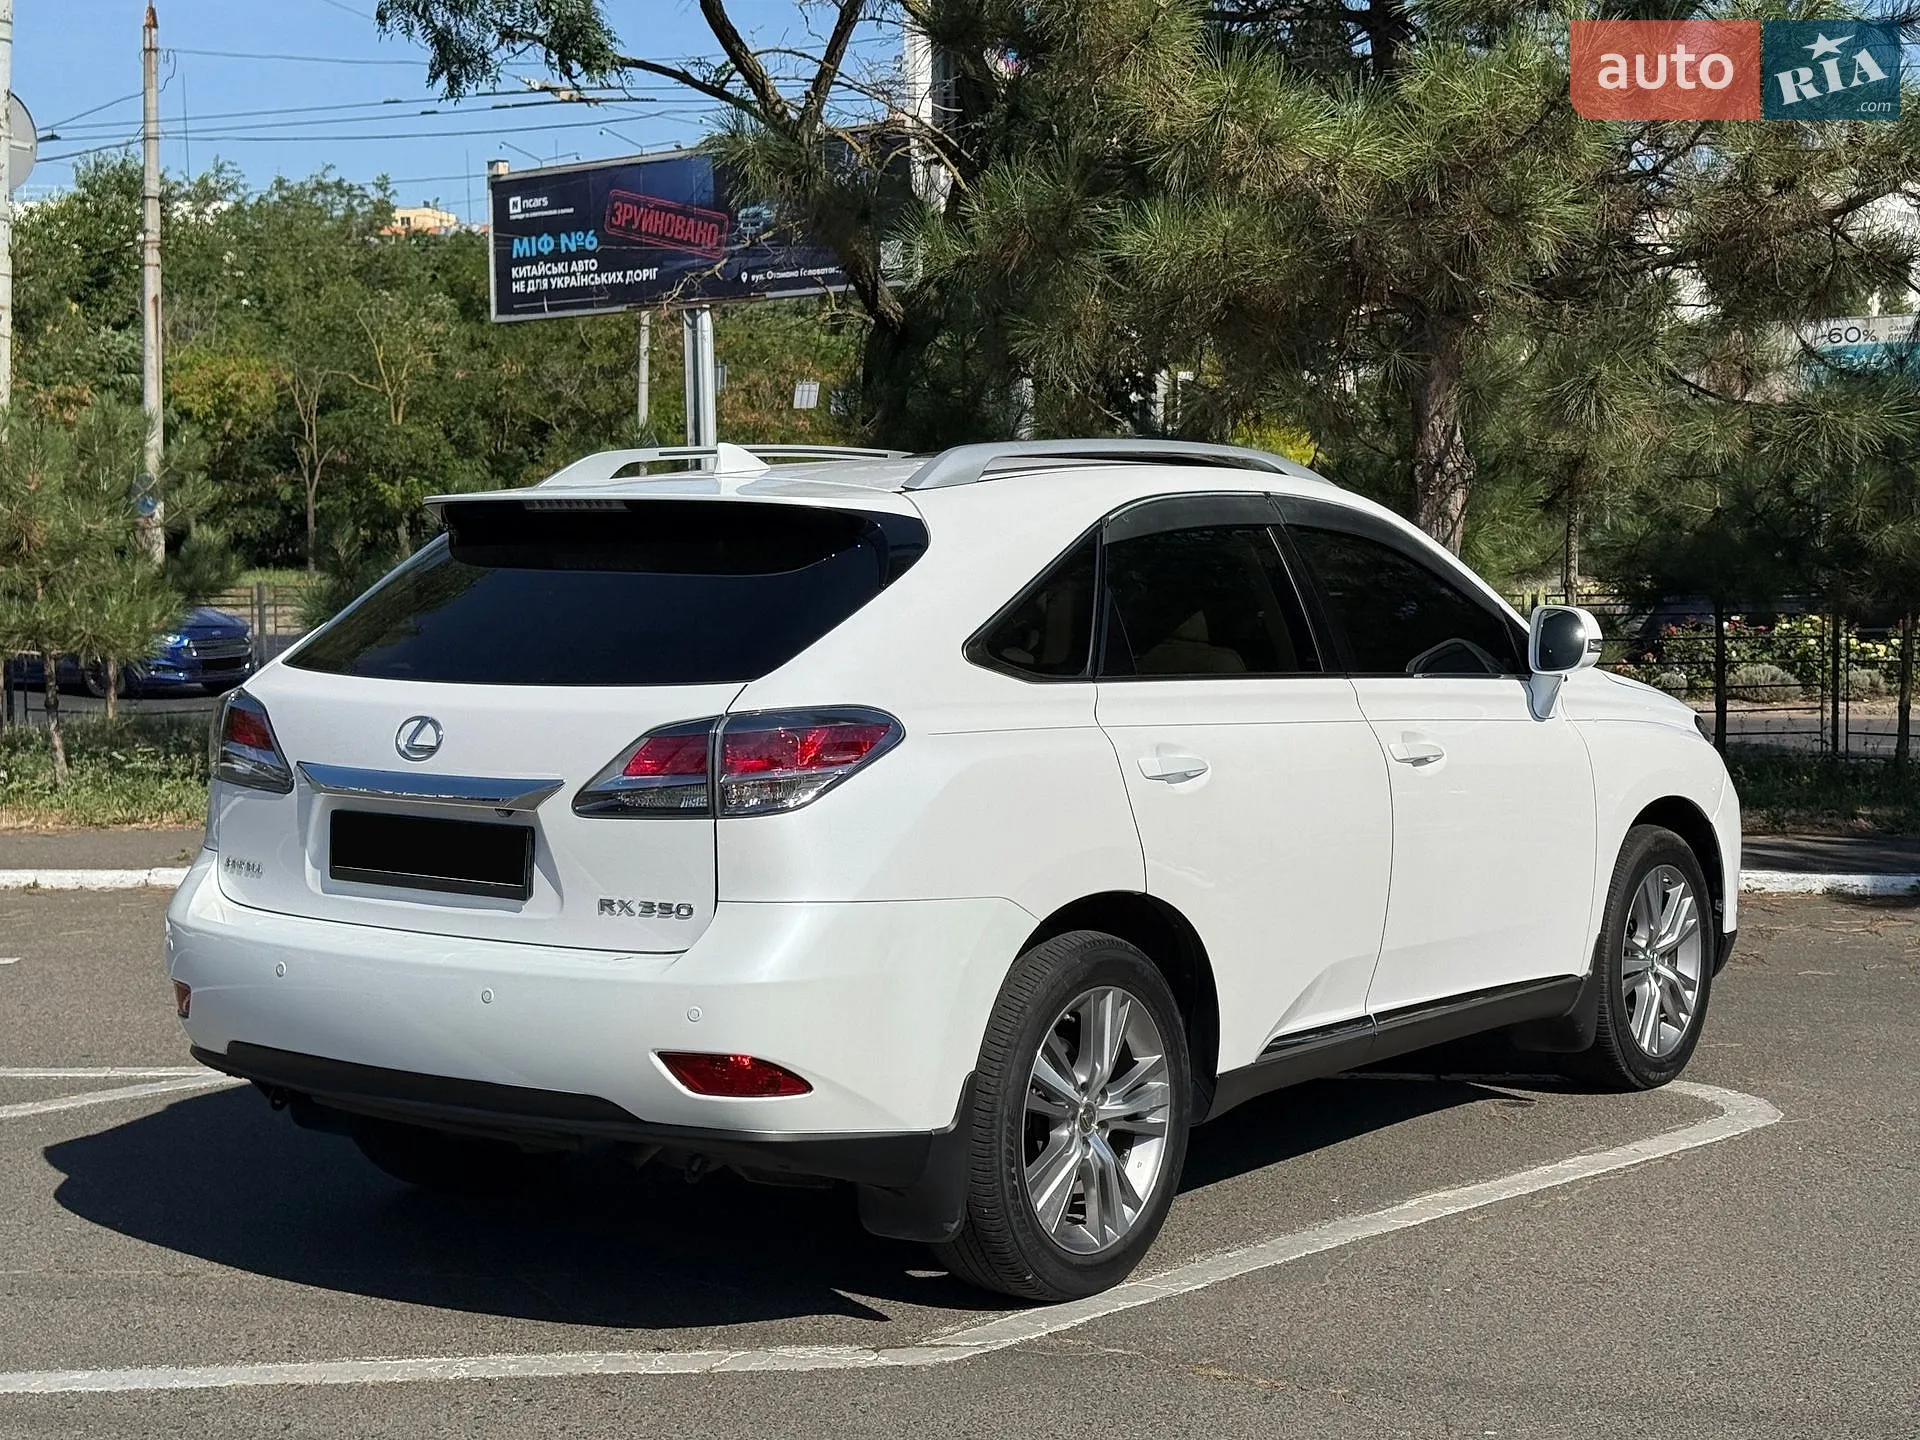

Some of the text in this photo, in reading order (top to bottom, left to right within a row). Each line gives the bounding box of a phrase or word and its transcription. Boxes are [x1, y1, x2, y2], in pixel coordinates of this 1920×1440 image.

[522, 196, 549, 210] ncars
[611, 201, 719, 249] ЗРУЙНОВАНО
[512, 233, 555, 259] МІФ
[511, 258, 598, 279] КИТАЙСЬКІ АВТО
[512, 267, 659, 294] НЕ ДЛЯ УКРАЇНСЬКИХ ДОРІГ
[598, 898, 694, 920] RX 350
